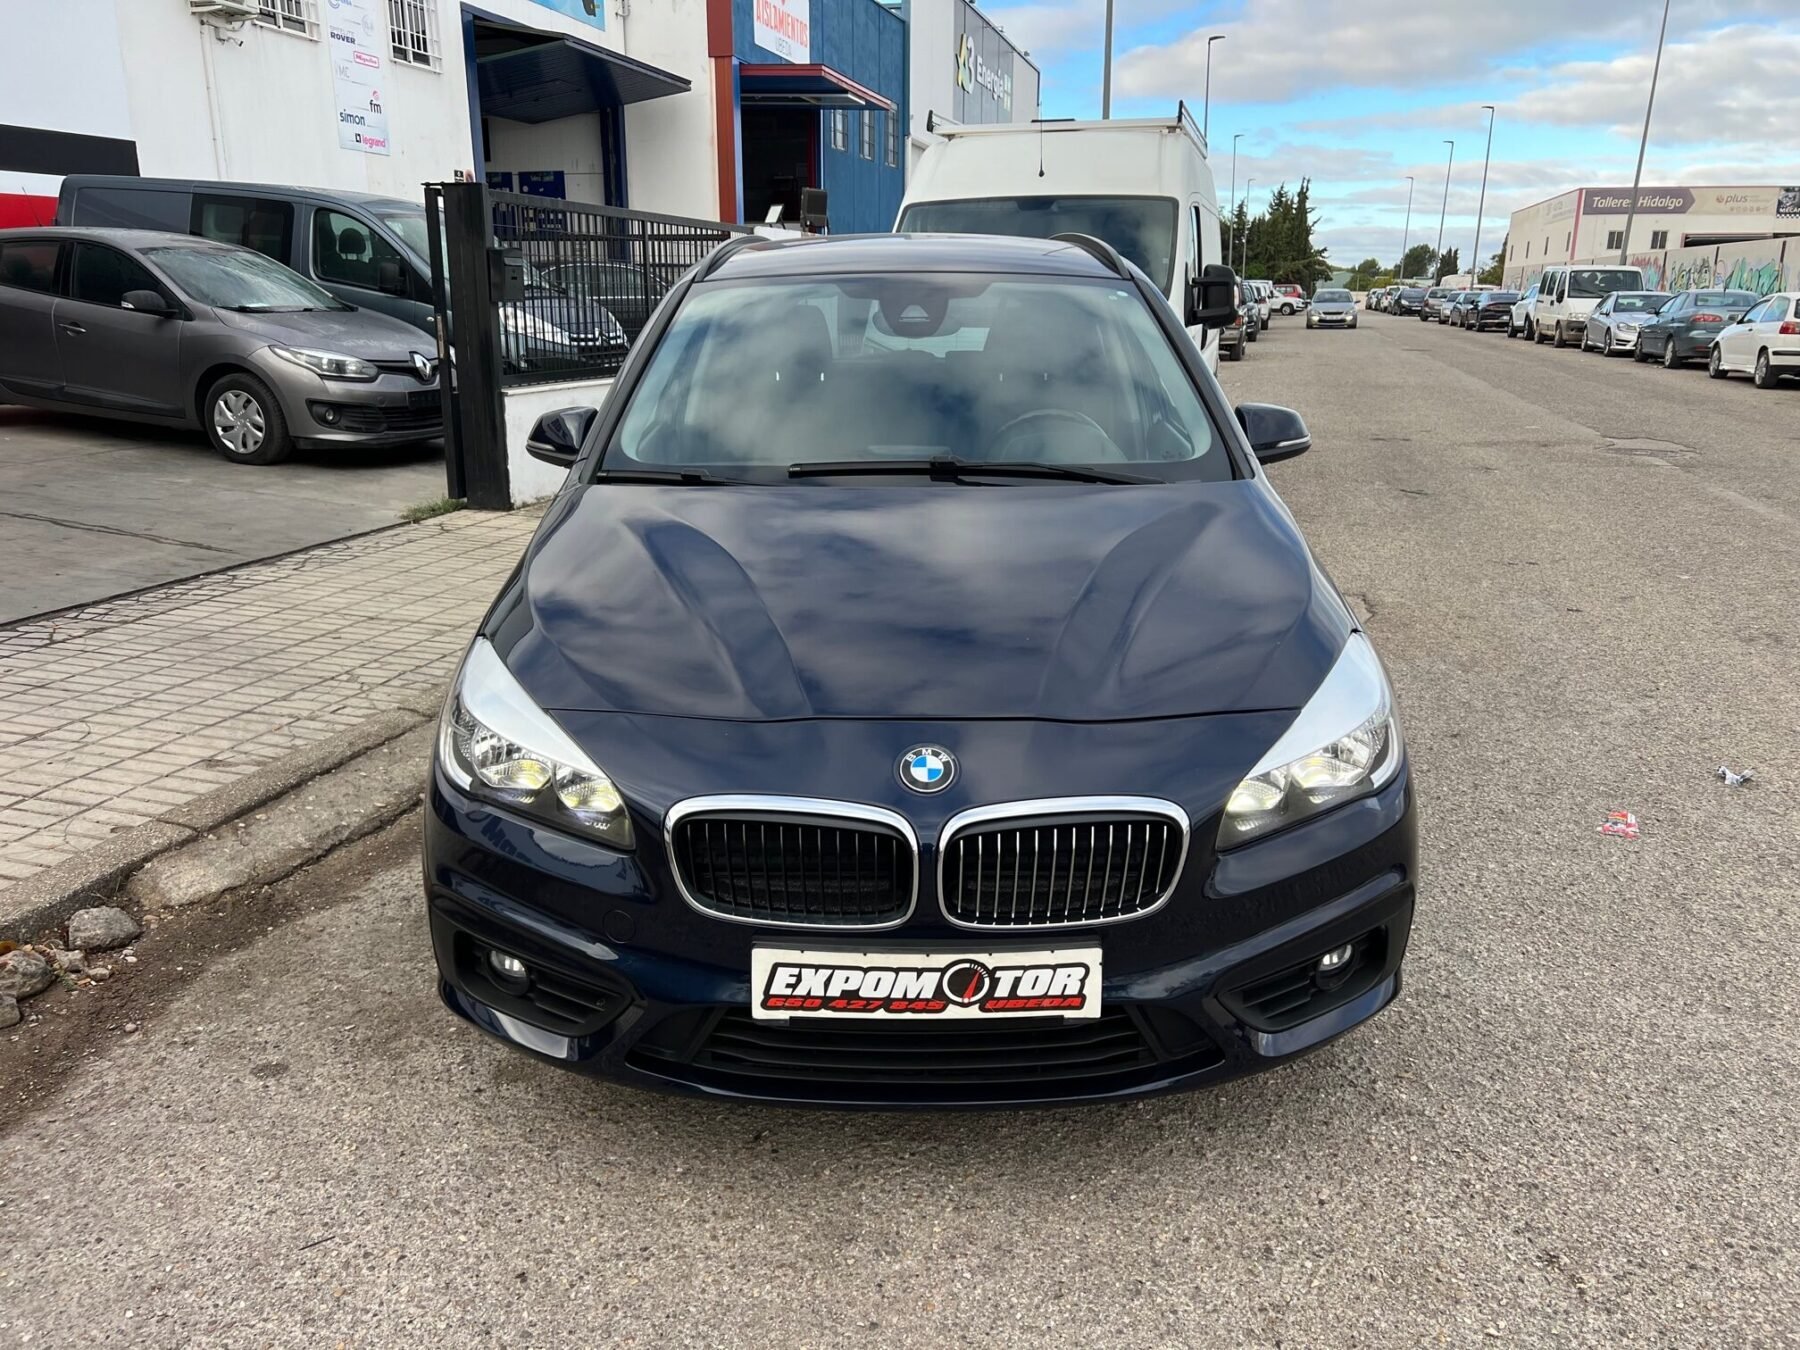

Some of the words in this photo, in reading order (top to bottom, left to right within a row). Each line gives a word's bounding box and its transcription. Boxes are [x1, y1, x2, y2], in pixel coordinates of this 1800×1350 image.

[330, 31, 356, 45] ROVER
[369, 99, 382, 115] fm
[339, 108, 366, 126] simon
[362, 134, 386, 149] legrand
[1638, 196, 1683, 210] Hidalgo
[1724, 193, 1748, 205] plus
[904, 747, 950, 763] BMW
[766, 997, 823, 1009] 650
[828, 999, 884, 1011] 427
[985, 997, 1083, 1009] UBEDA
